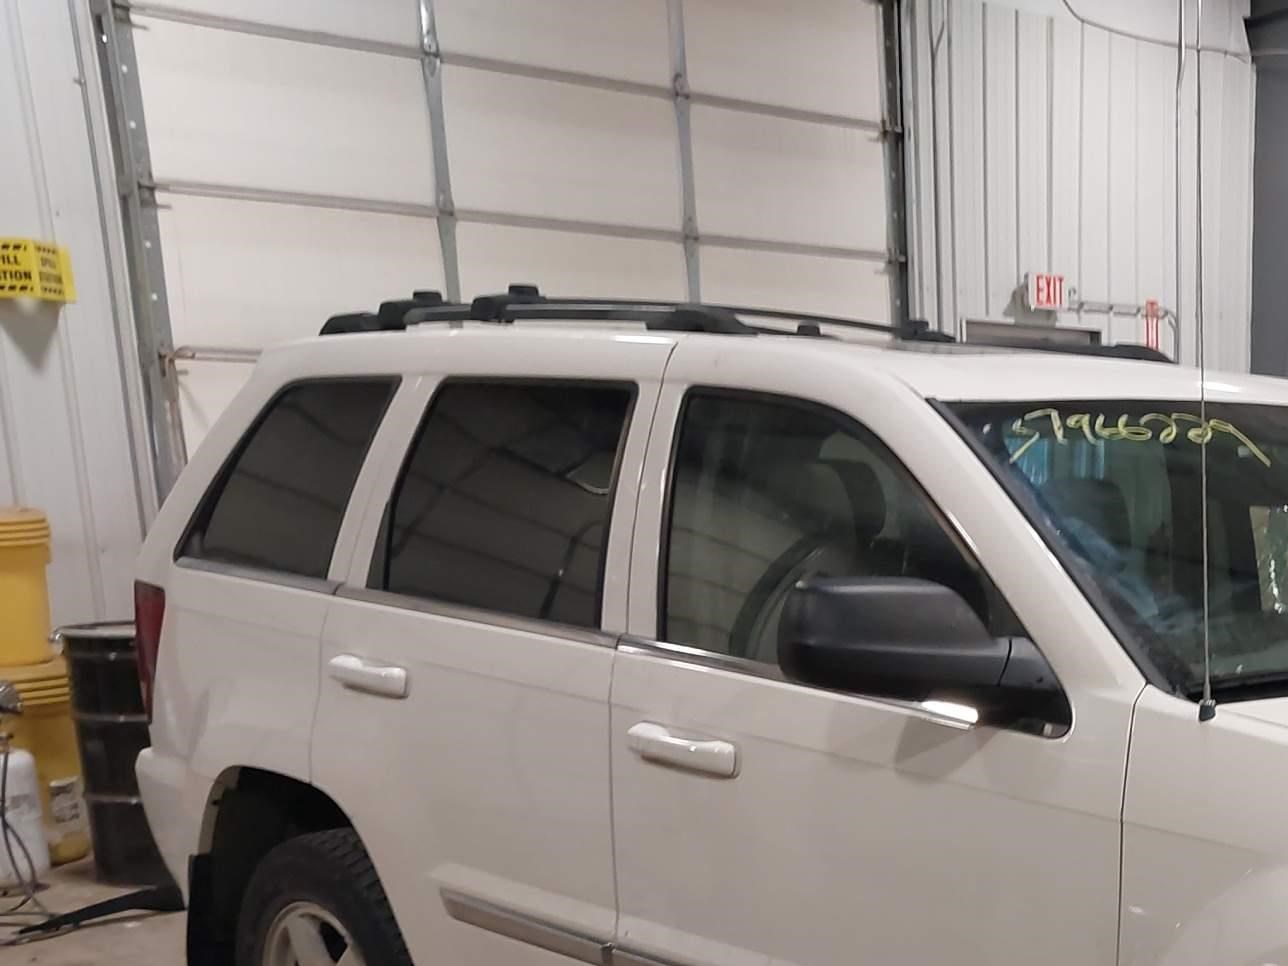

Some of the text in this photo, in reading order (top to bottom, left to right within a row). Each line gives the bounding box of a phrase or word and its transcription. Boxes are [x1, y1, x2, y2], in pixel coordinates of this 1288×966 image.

[0, 254, 21, 267] ILL
[0, 270, 32, 281] TION
[1036, 275, 1064, 306] EXIT
